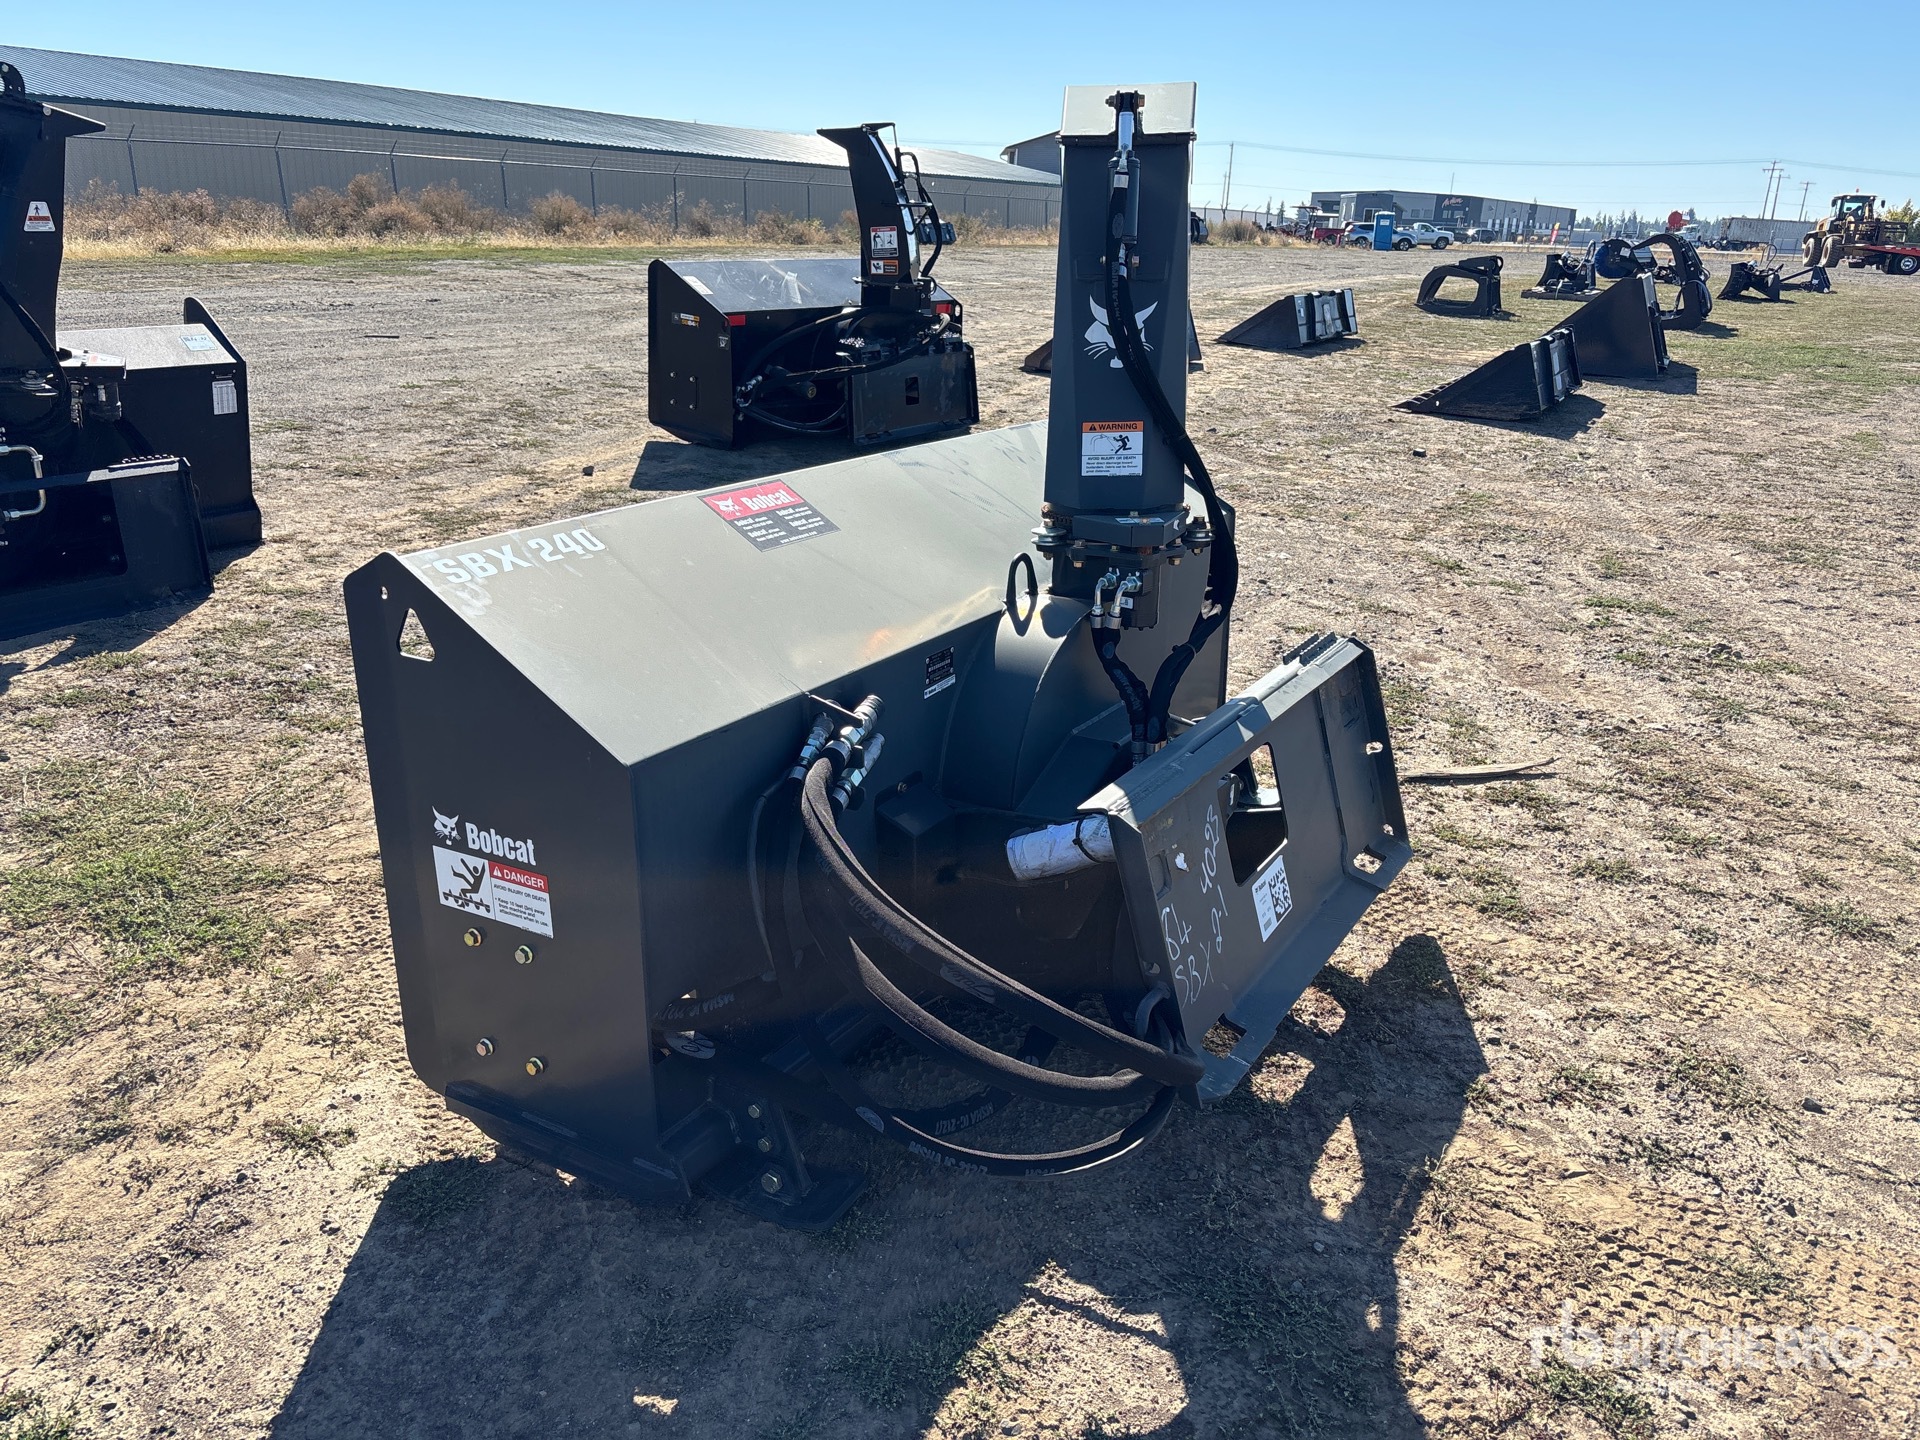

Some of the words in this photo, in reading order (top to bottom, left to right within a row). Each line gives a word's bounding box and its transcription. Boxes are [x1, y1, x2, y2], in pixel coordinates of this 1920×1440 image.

[740, 489, 795, 511] Bobcat
[432, 544, 533, 584] SBX
[527, 528, 606, 562] 240
[465, 821, 537, 866] Bobcat
[503, 869, 545, 890] DANGER
